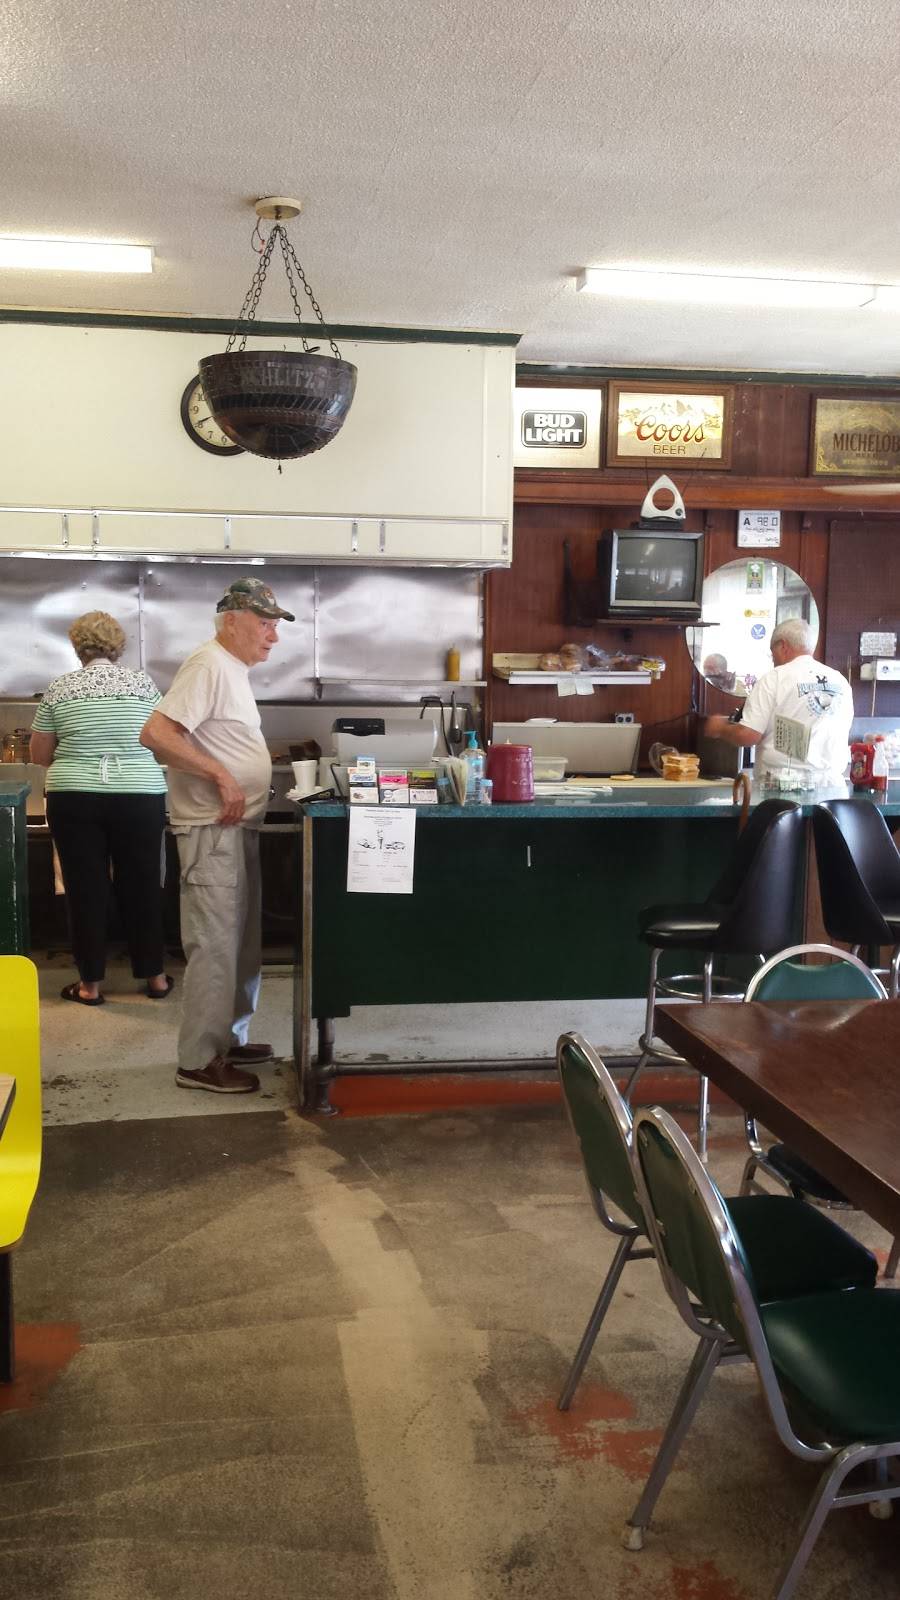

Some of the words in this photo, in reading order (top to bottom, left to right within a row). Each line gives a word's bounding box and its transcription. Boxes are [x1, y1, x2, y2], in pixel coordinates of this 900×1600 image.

[533, 413, 575, 428] BUD
[525, 428, 583, 443] LIGHT
[634, 415, 706, 443] Coors
[653, 445, 686, 455] BEER
[832, 432, 900, 453] MICHELOB
[743, 517, 751, 526] A
